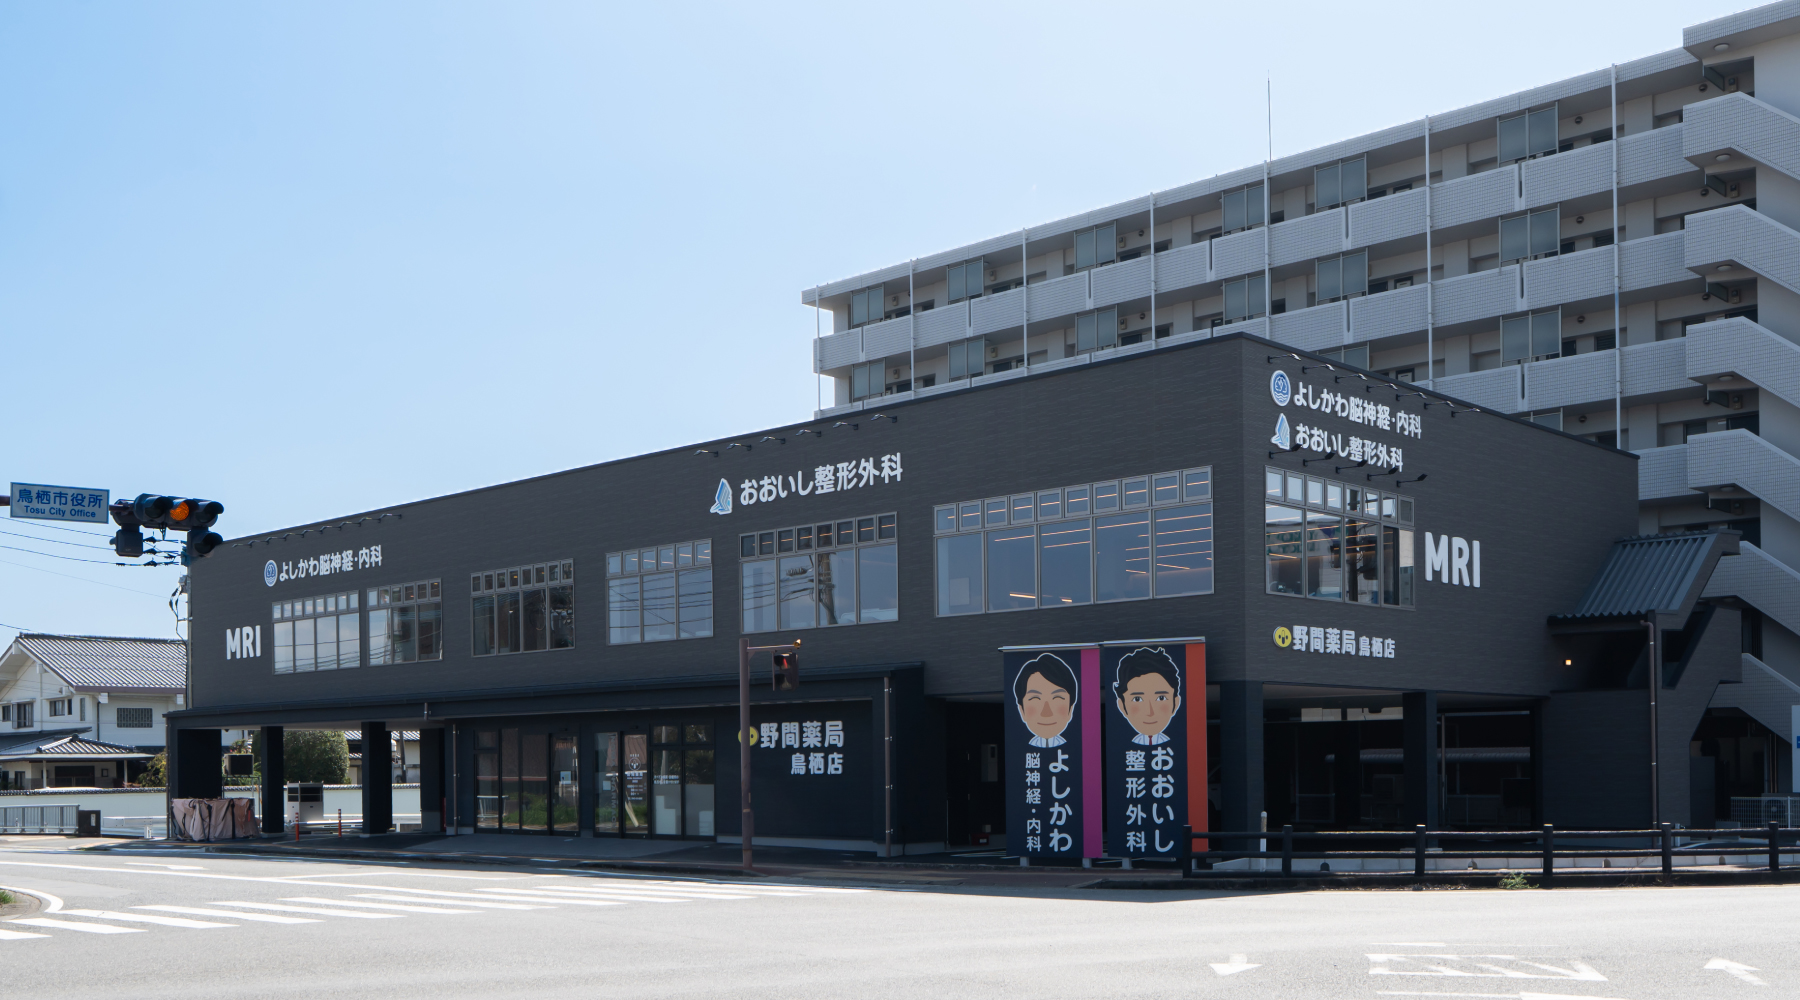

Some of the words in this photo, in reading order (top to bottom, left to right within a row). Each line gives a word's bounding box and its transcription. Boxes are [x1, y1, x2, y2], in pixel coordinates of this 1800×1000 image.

[1293, 381, 1422, 440] よしかわ脳神経・内科
[1295, 423, 1404, 472] おおいし整形外科
[17, 488, 104, 509] 鳥栖市役所
[740, 452, 903, 506] おおいし整形外科
[24, 505, 46, 515] Tosu
[49, 506, 66, 518] City
[69, 508, 97, 518] Office
[279, 544, 383, 582] よしかわ脳神経・内科
[1424, 531, 1481, 588] MRI
[226, 624, 262, 660] MRI
[760, 720, 845, 749] 野間薬局
[790, 752, 844, 775] 鳥栖店
[1025, 752, 1042, 852] 脳神経・内科
[1049, 749, 1073, 852] よしかわ
[1125, 750, 1147, 853] 整形外科
[1151, 747, 1175, 853] おおいし
